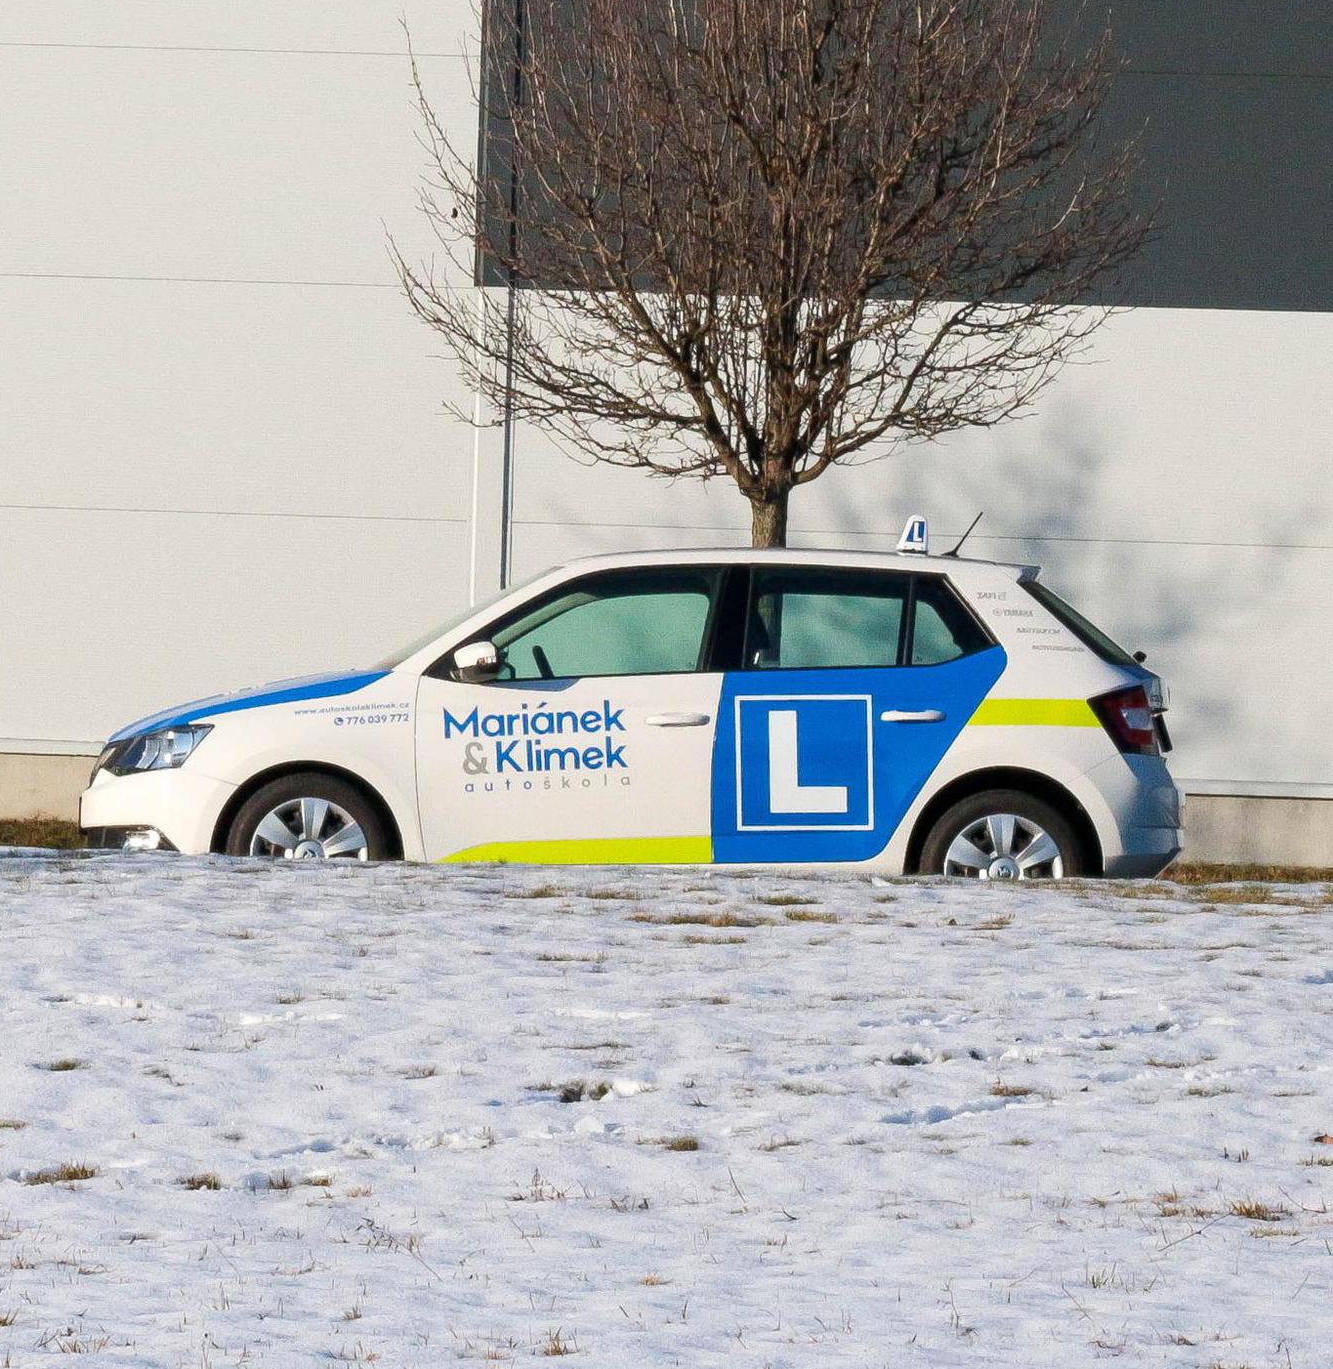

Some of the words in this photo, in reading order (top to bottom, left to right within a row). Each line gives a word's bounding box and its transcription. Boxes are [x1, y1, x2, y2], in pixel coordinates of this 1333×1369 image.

[913, 522, 922, 542] L
[346, 716, 366, 726] 776
[367, 714, 388, 724] 039
[389, 713, 409, 723] 772
[443, 699, 626, 740] Mariánek
[462, 742, 489, 775] &
[495, 735, 628, 773] Klimek
[769, 711, 848, 814] L
[464, 774, 631, 793] autoškola
